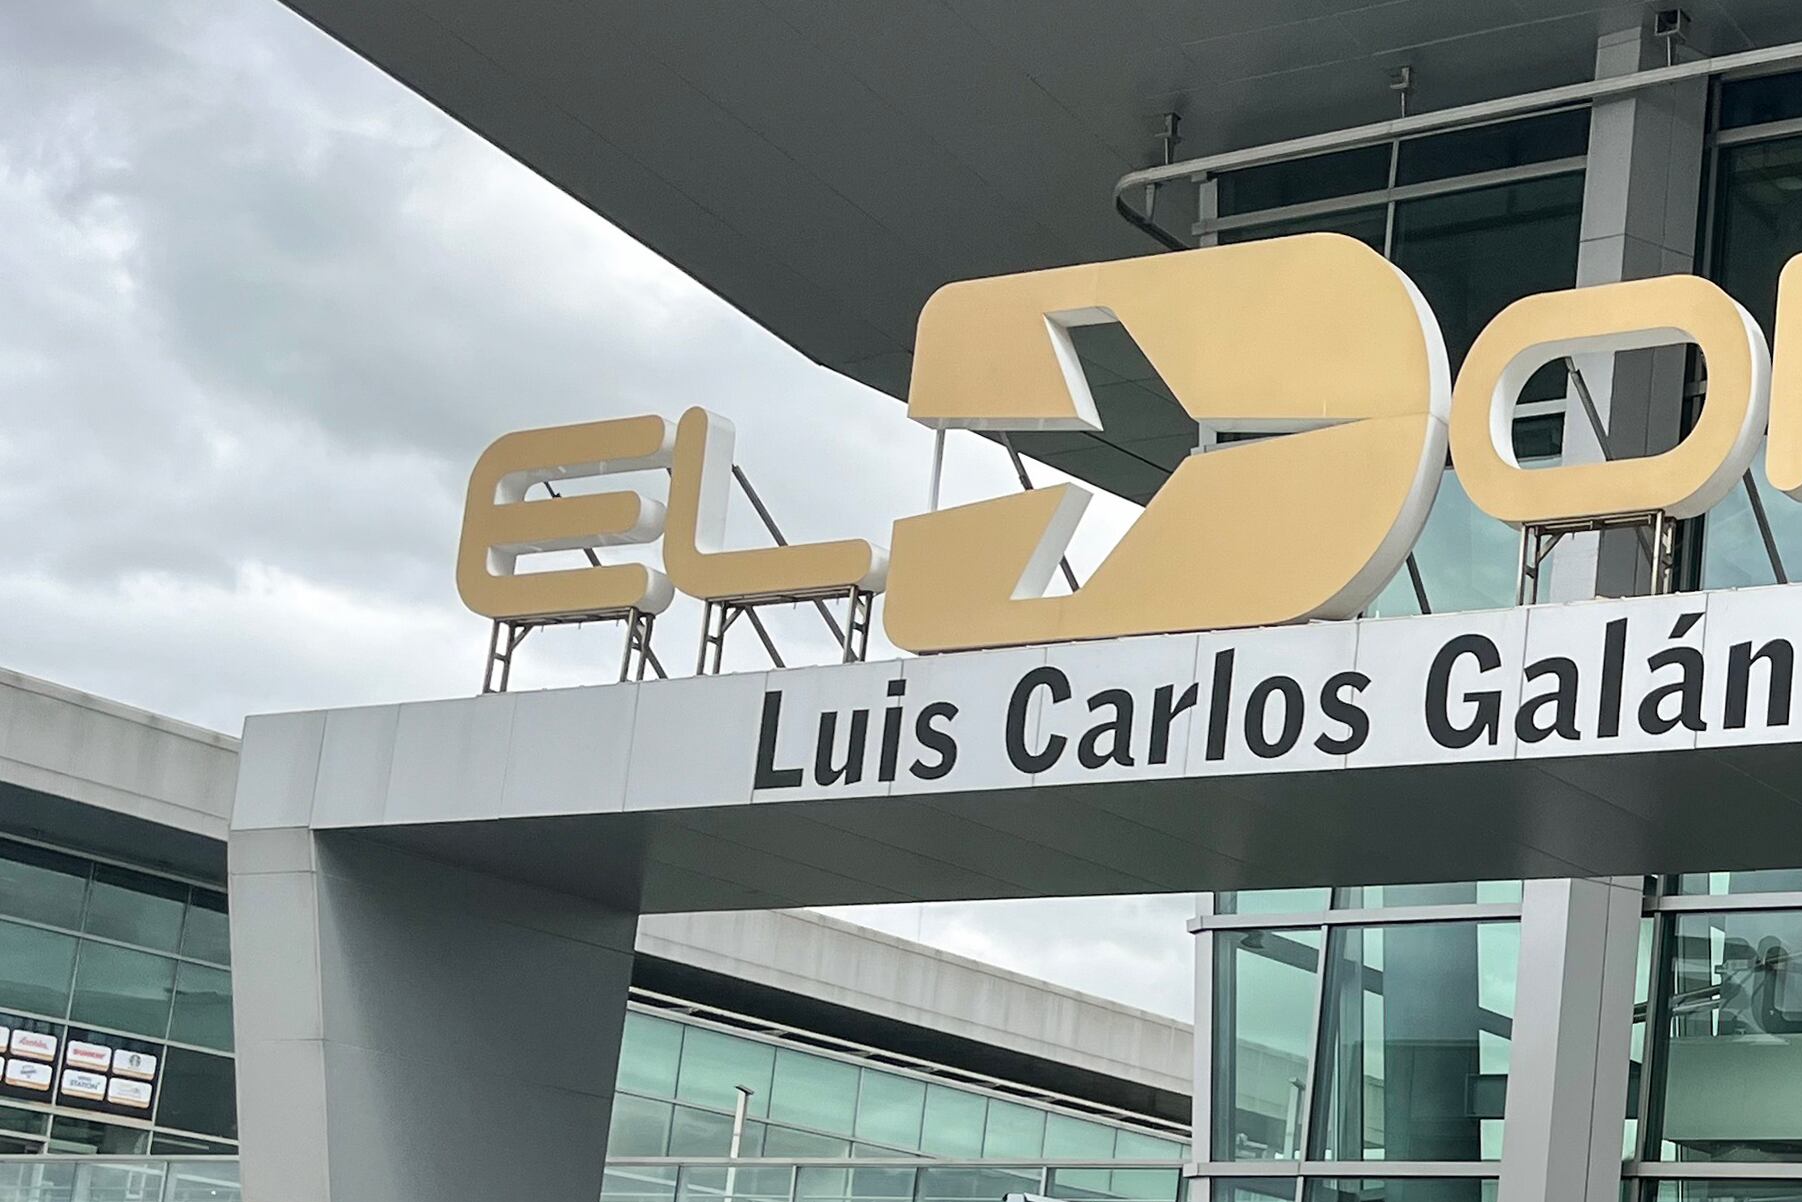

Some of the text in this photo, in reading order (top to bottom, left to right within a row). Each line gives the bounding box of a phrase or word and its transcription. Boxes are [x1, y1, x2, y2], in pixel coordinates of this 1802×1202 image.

[456, 405, 888, 620] EL
[752, 678, 959, 791] Luis
[1005, 647, 1372, 775] Carlos
[1424, 611, 1794, 750] Galán
